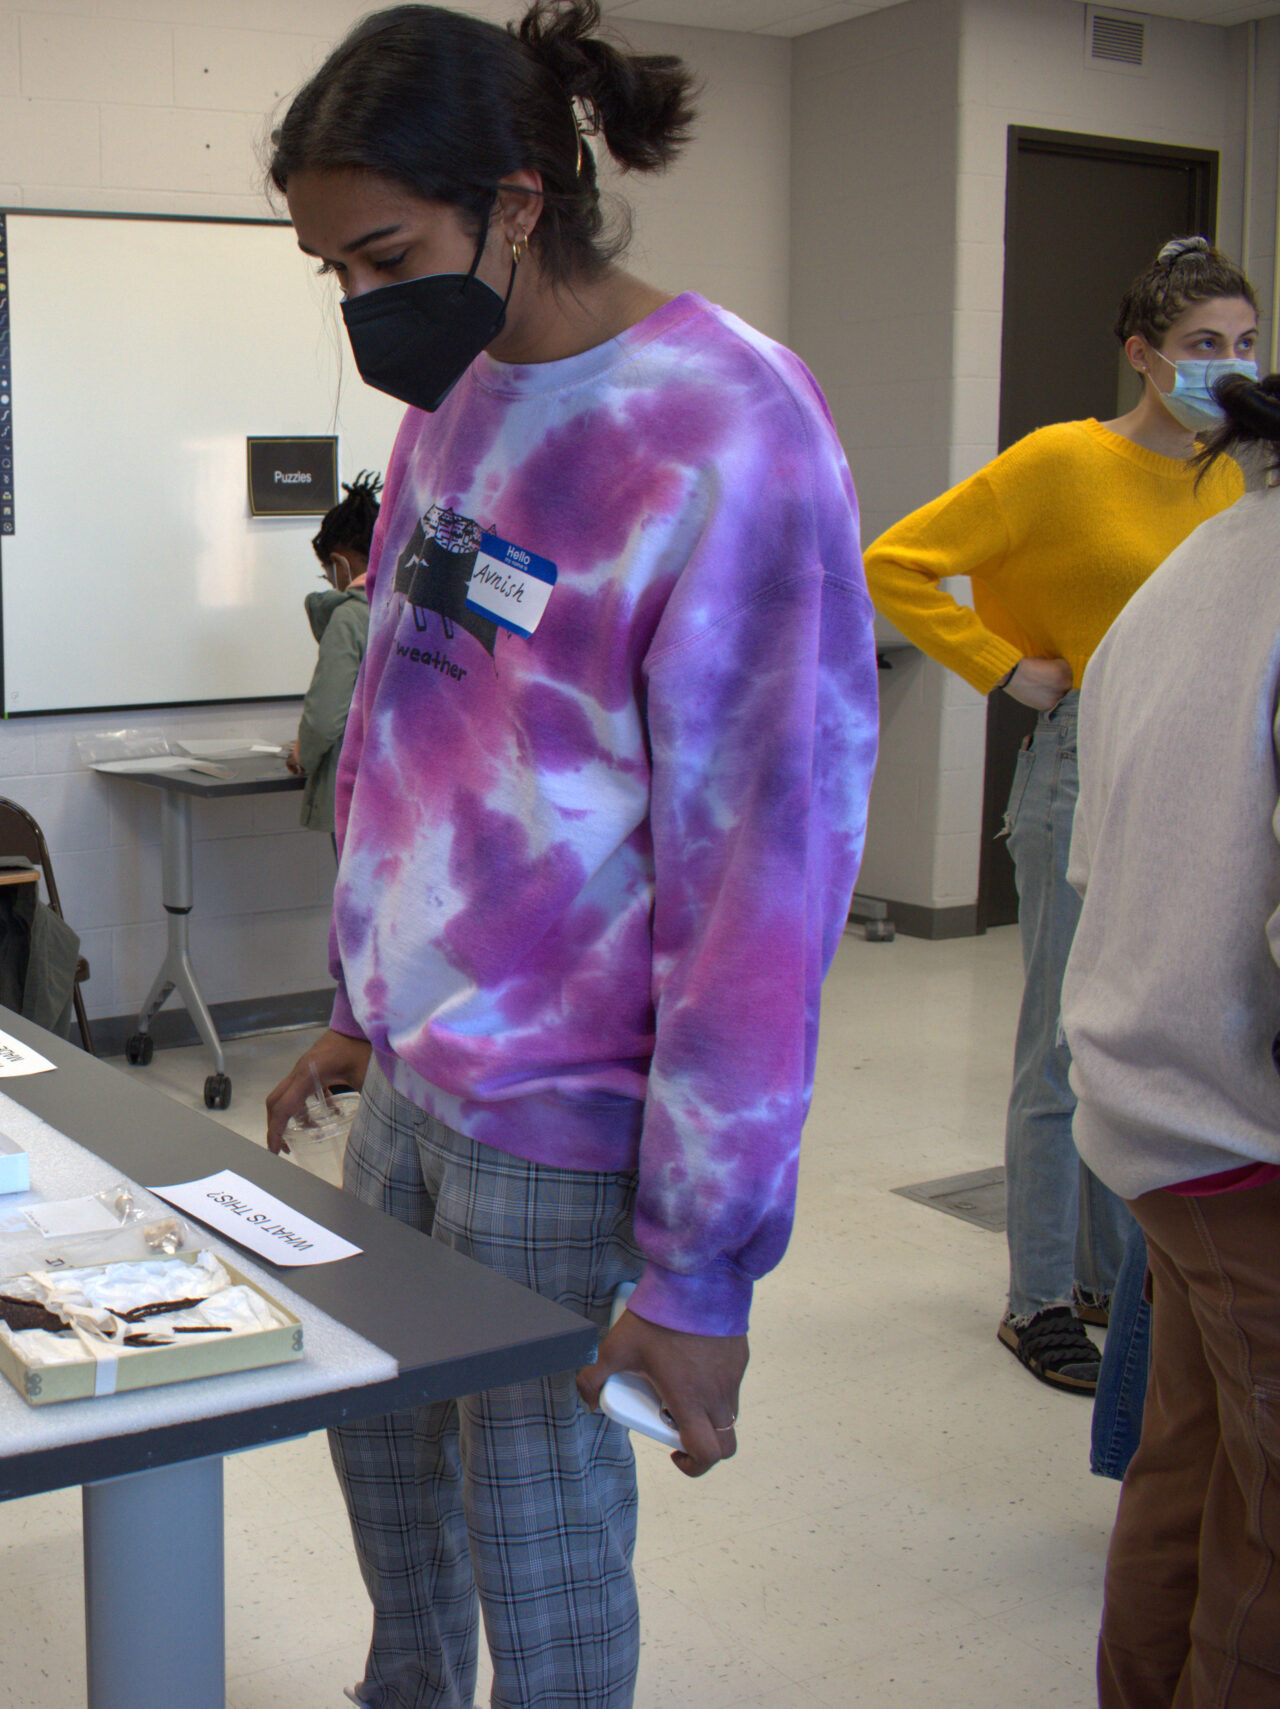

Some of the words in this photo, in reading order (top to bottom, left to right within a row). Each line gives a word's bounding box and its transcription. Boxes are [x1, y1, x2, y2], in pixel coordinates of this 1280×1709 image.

[273, 470, 313, 484] Puzzles
[506, 544, 531, 566] Hello
[473, 563, 525, 603] Avnish
[396, 642, 468, 682] weather
[206, 1191, 253, 1216] THIS?
[246, 1214, 272, 1225] IS
[260, 1224, 314, 1251] WHAT
